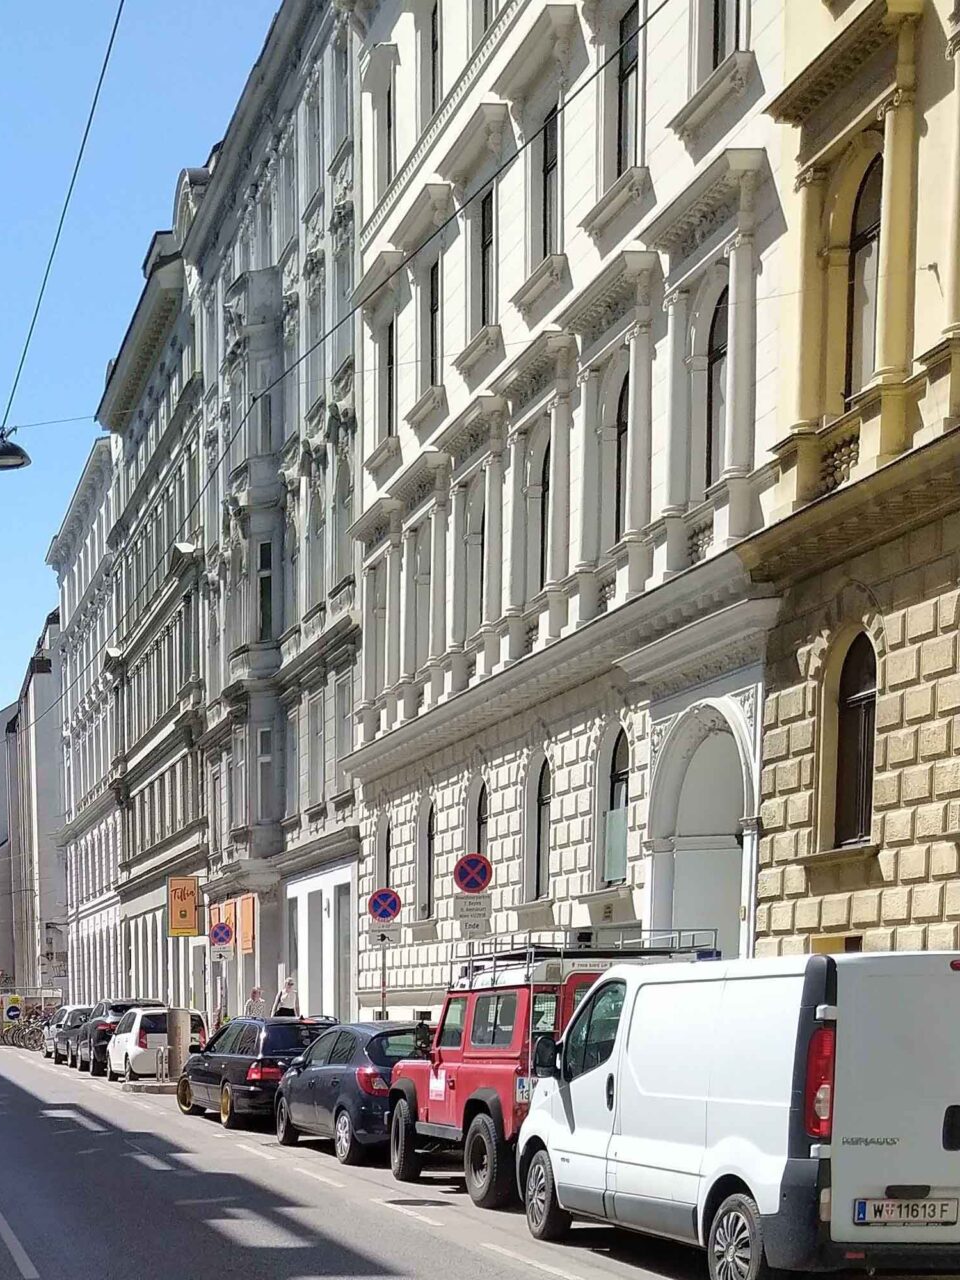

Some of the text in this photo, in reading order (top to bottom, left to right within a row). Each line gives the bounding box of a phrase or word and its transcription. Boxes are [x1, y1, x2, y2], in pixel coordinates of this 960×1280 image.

[171, 886, 195, 902] Tiffin
[464, 922, 480, 930] Ende
[873, 1203, 884, 1219] W
